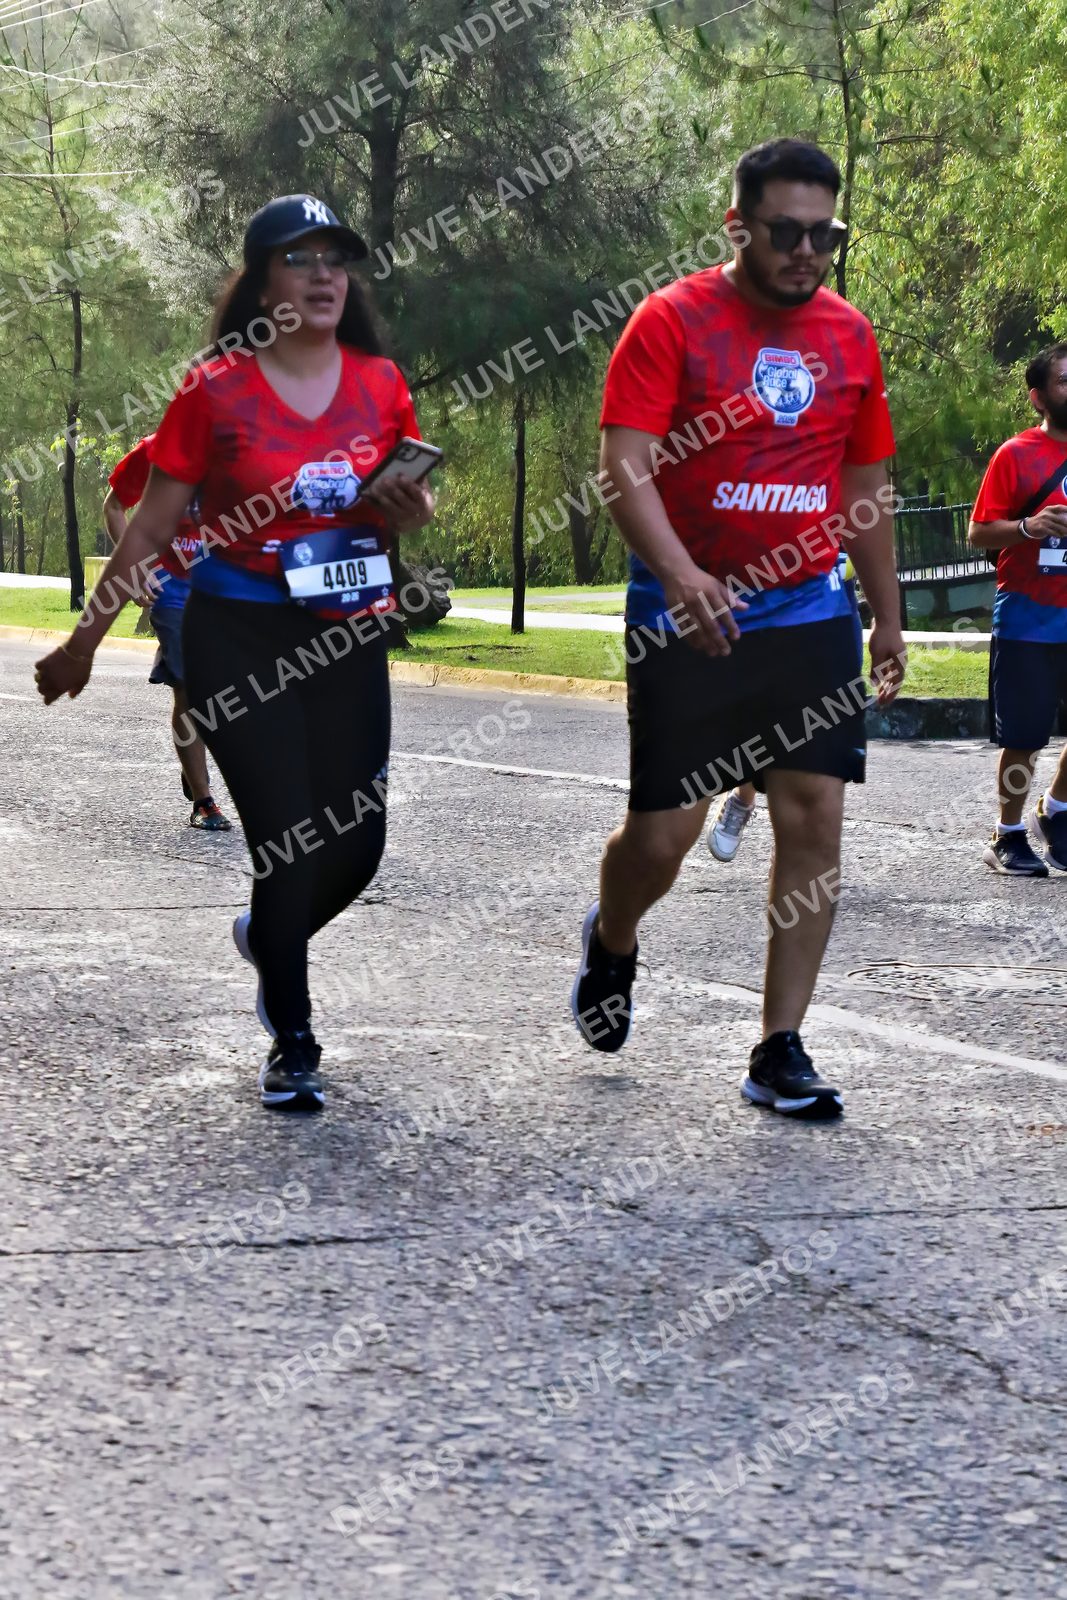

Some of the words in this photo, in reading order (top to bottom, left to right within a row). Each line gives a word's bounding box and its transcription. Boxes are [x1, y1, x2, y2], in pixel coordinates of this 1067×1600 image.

[763, 375, 788, 388] Race
[767, 367, 799, 379] Global
[712, 481, 827, 513] SANTIAGO
[324, 560, 368, 590] 4409
